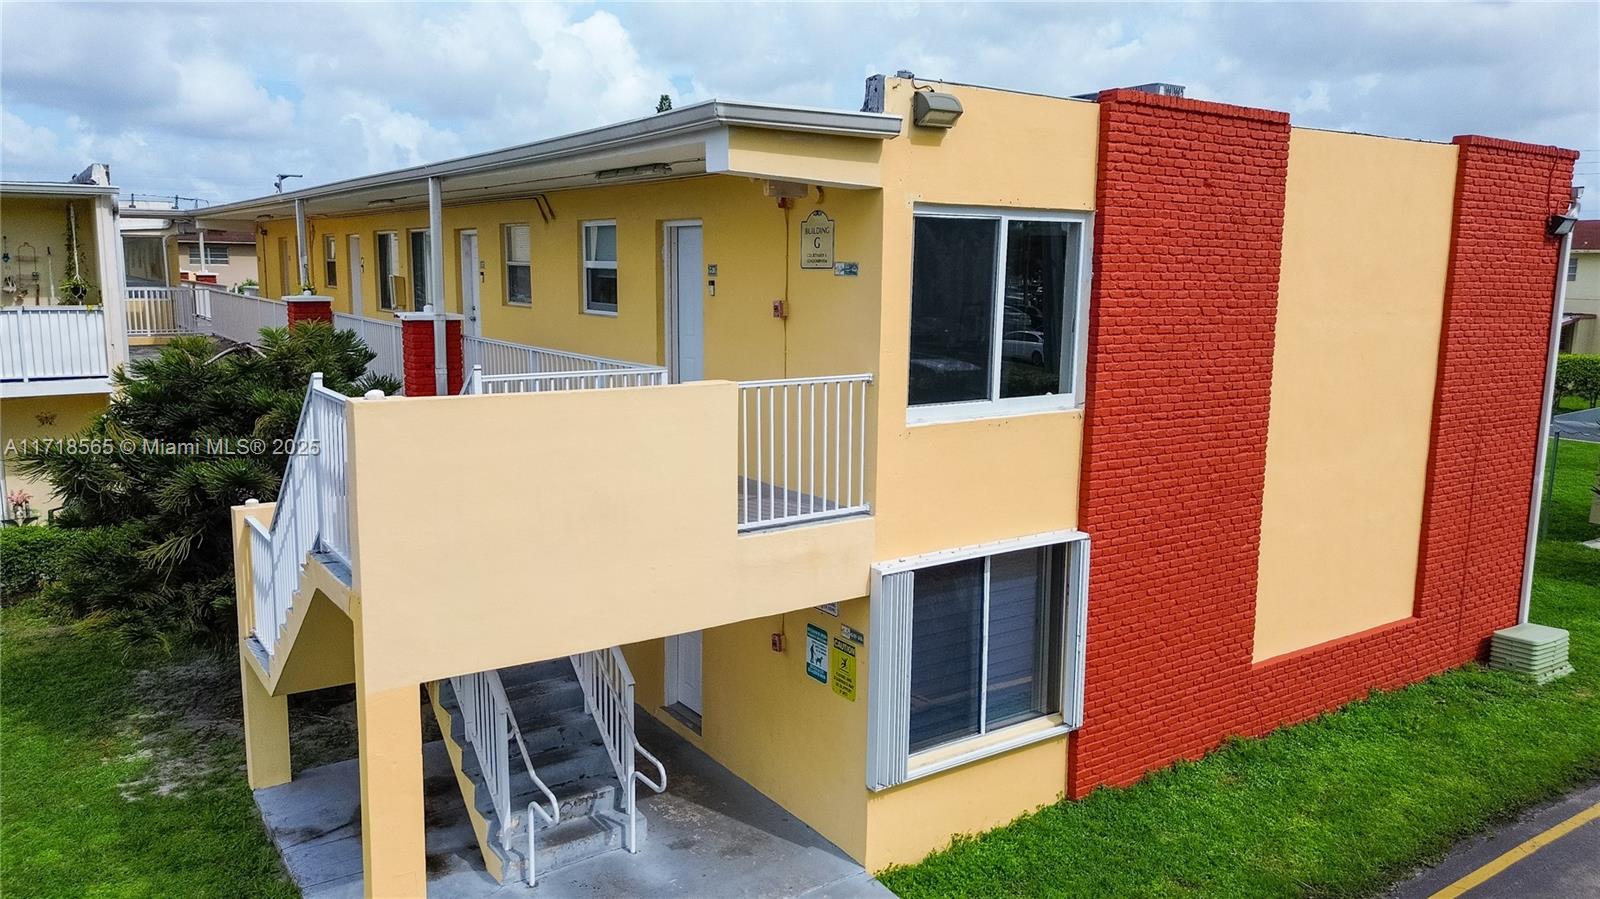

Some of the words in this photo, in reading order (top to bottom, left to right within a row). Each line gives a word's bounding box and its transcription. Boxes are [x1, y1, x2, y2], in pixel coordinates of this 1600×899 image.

[805, 226, 830, 235] BUILDING
[814, 237, 821, 248] G
[834, 639, 855, 656] CAUTION
